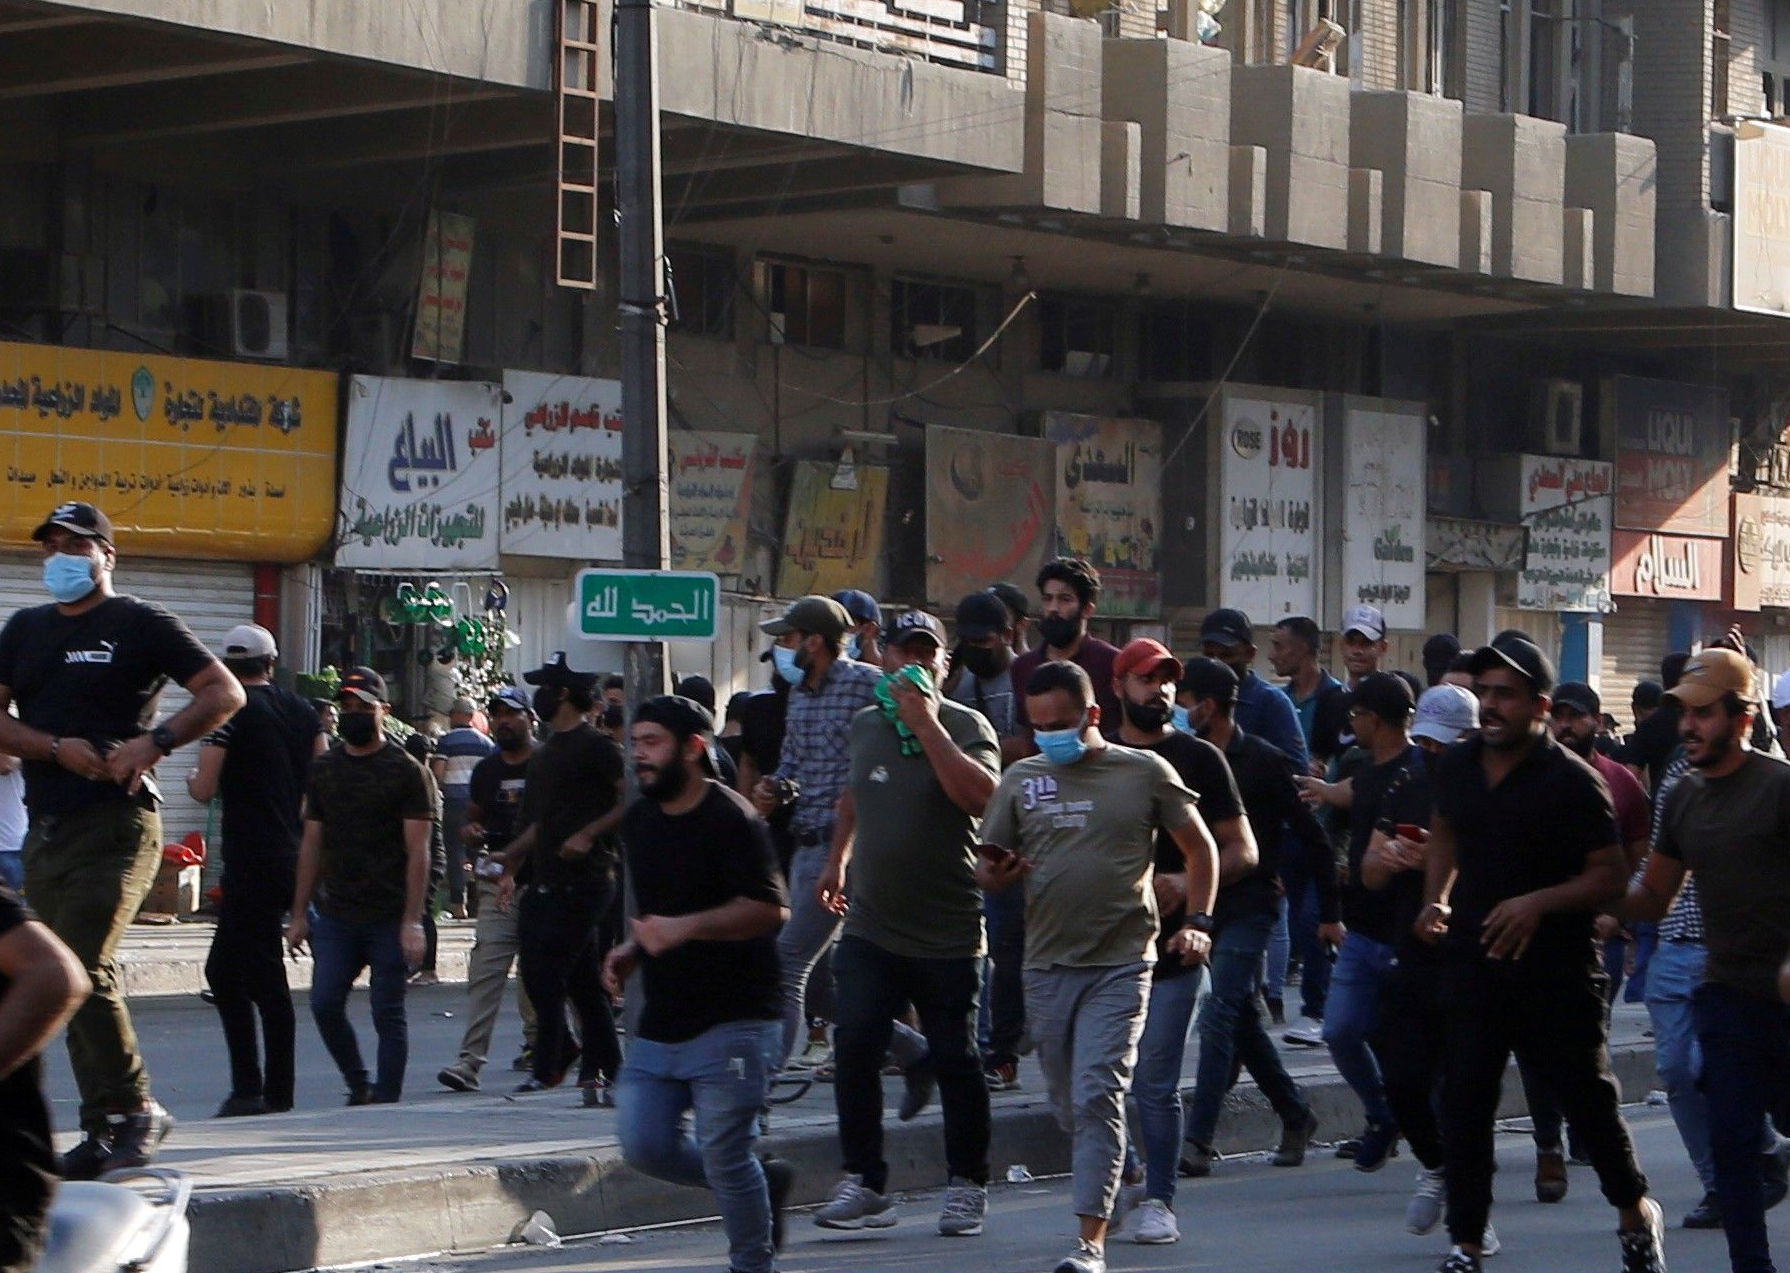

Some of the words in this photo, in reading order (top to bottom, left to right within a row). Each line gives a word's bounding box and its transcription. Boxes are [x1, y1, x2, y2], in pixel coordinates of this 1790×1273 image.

[387, 411, 457, 492] البياع
[1237, 428, 1261, 450] ROSE
[1064, 441, 1137, 502] السعدي
[1634, 534, 1701, 595] السلام
[586, 585, 619, 618] لله
[631, 588, 710, 626] الحمد
